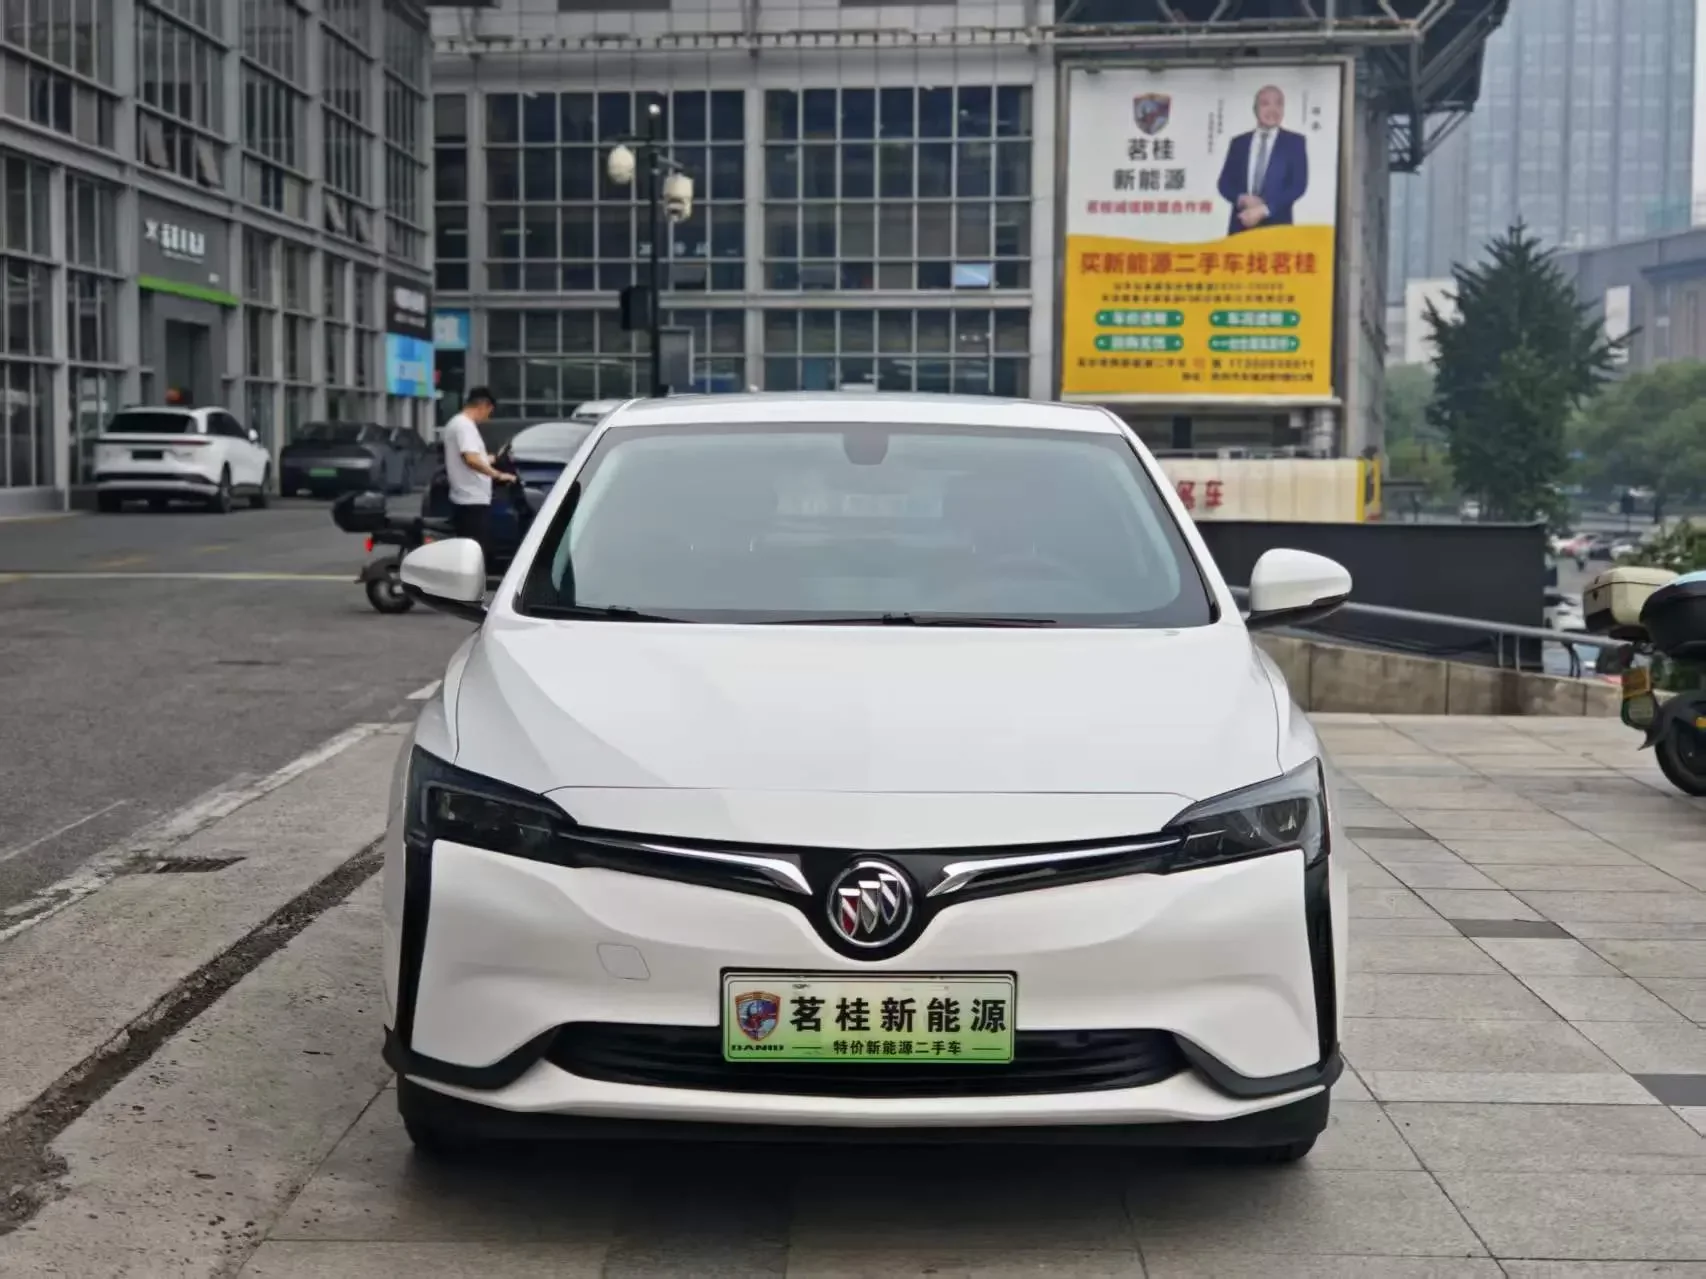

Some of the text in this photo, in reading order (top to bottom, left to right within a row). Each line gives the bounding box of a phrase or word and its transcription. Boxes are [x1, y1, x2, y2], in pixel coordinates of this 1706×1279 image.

[1127, 138, 1175, 161] 茗桂
[1113, 168, 1186, 190] 新能源
[1081, 252, 1316, 275] 买新能源二手车找茗桂
[789, 997, 1007, 1033] 茗桂新能源
[833, 1040, 962, 1056] 特价新能源二手车
